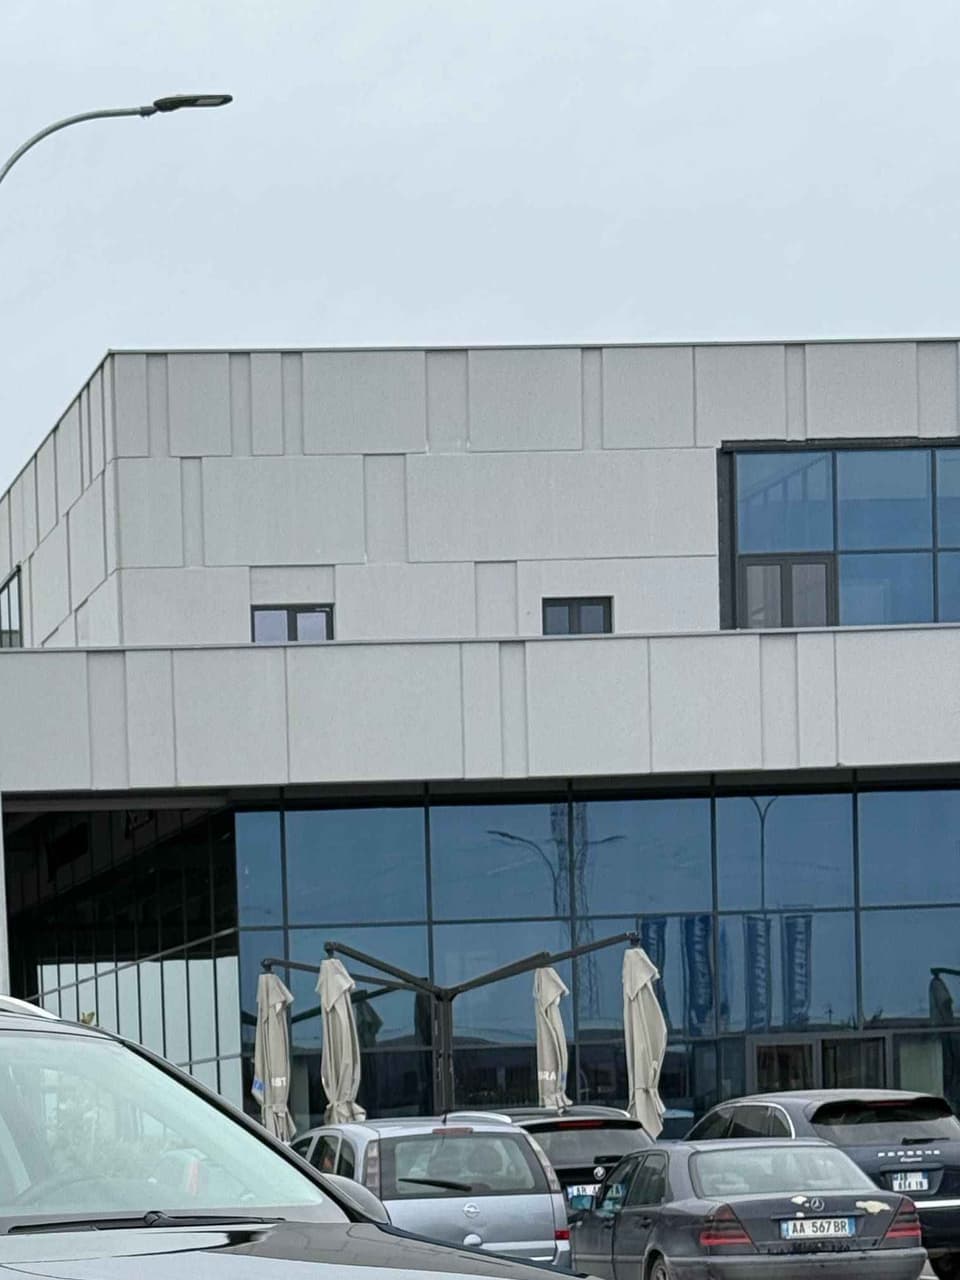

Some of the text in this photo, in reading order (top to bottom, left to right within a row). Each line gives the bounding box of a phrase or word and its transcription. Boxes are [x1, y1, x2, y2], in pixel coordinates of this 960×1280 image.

[792, 1219, 848, 1234] AA 567 BR
